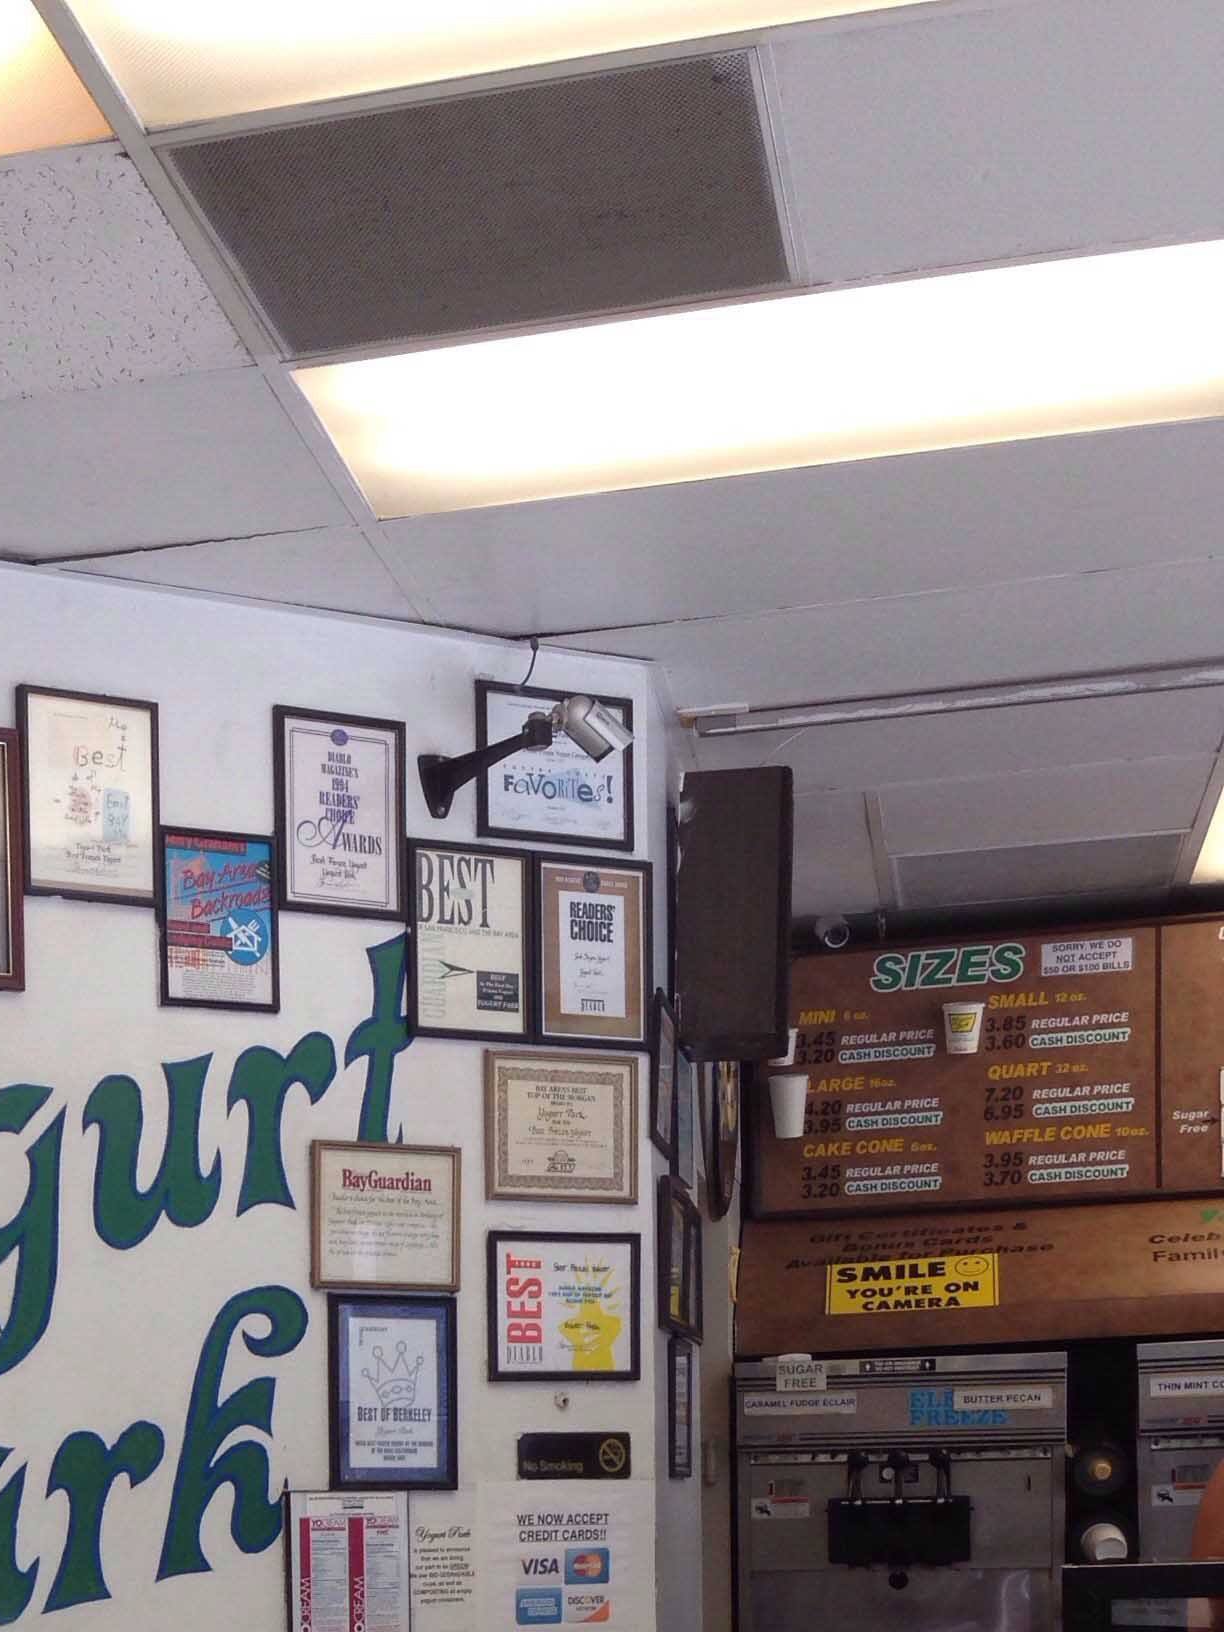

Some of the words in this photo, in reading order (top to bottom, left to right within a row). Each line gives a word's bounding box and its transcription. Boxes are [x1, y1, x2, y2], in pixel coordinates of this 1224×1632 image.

[325, 807, 355, 824] CHOICE
[297, 812, 383, 856] AWARDS
[183, 868, 216, 890] Bay
[417, 852, 495, 929] BEST
[570, 901, 616, 921] READERS'
[570, 919, 614, 943] CHOICE
[1108, 940, 1121, 948] DO
[1057, 954, 1075, 963] NOT
[1079, 951, 1117, 960] ACCEPT
[871, 943, 1025, 992] SIZES
[1062, 965, 1075, 973] OR
[1102, 961, 1129, 969] BILLS
[988, 991, 1048, 1010] SMALL
[798, 1009, 836, 1025] MINI
[1031, 1014, 1090, 1029] REGULAR
[1092, 1012, 1129, 1025] PRICE
[840, 1032, 896, 1045] REGULAR
[899, 1029, 935, 1041] PRICE
[1031, 1036, 1063, 1047] CASH
[1066, 1031, 1128, 1045] DISCOUNT
[840, 1051, 872, 1061] CASH
[874, 1046, 933, 1059] DISCOUNT
[988, 1061, 1051, 1080] QUART
[807, 1077, 864, 1093] LARGE
[1033, 1086, 1090, 1100] REGULAR
[1093, 1083, 1130, 1096] PRICE
[846, 1101, 901, 1114] REGULAR
[903, 1098, 939, 1110] PRICE
[1035, 1105, 1067, 1117] CASH
[1069, 1101, 1131, 1115] DISCOUNT
[847, 1118, 879, 1129] CASH
[881, 1114, 941, 1127] DISCOUNT
[1172, 1109, 1210, 1122] Sugar
[985, 1127, 1056, 1144] WAFFLE
[1060, 1123, 1111, 1140] CONE
[1179, 1124, 1209, 1134] Free
[803, 1141, 851, 1158] CAKE
[856, 1138, 904, 1156] CONE
[1028, 1153, 1086, 1165] REGULAR
[1089, 1150, 1126, 1163] PRICE
[846, 1166, 901, 1178] REGULAR
[903, 1163, 939, 1175] PRICE
[1030, 1171, 1062, 1182] CASH
[1065, 1167, 1128, 1181] DISCOUNT
[342, 1169, 432, 1192] BayGuardian
[846, 1182, 877, 1193] CASH
[879, 1178, 939, 1192] DISCOUNT
[810, 1232, 851, 1244] Gift
[858, 1224, 1004, 1242] Certificates
[842, 1241, 915, 1253] Bonus
[924, 1234, 993, 1247] Cards
[900, 1251, 931, 1261] for
[837, 1261, 946, 1283] SMILE
[846, 1284, 933, 1299] YOU'RE
[944, 1281, 979, 1293] ON
[506, 1253, 542, 1344] BEST
[862, 1296, 961, 1311] CAMERA
[777, 1364, 824, 1375] SUGAR
[784, 1378, 817, 1389] FREE
[1158, 1383, 1181, 1391] THIN
[1184, 1381, 1209, 1389] MINT
[745, 1400, 787, 1409] CARAMEL
[789, 1400, 820, 1409] FUDGE
[823, 1398, 856, 1408] ECLAIR
[963, 1394, 1004, 1404] BUTTER
[1006, 1393, 1041, 1403] PECAN
[357, 1406, 377, 1421] BEST
[381, 1408, 392, 1421] OF
[393, 1408, 432, 1422] BERKELEY
[910, 1409, 1008, 1426] FREEZE
[523, 1461, 539, 1472] No
[539, 1460, 584, 1473] Smoking
[517, 1514, 535, 1525] WE
[538, 1514, 564, 1525] NOW
[567, 1513, 609, 1525] ACCEPT
[519, 1530, 558, 1542] CREDIT
[562, 1529, 607, 1541] CARDS!!
[521, 1558, 560, 1575] VISA
[568, 1596, 605, 1606] DISCOVER
